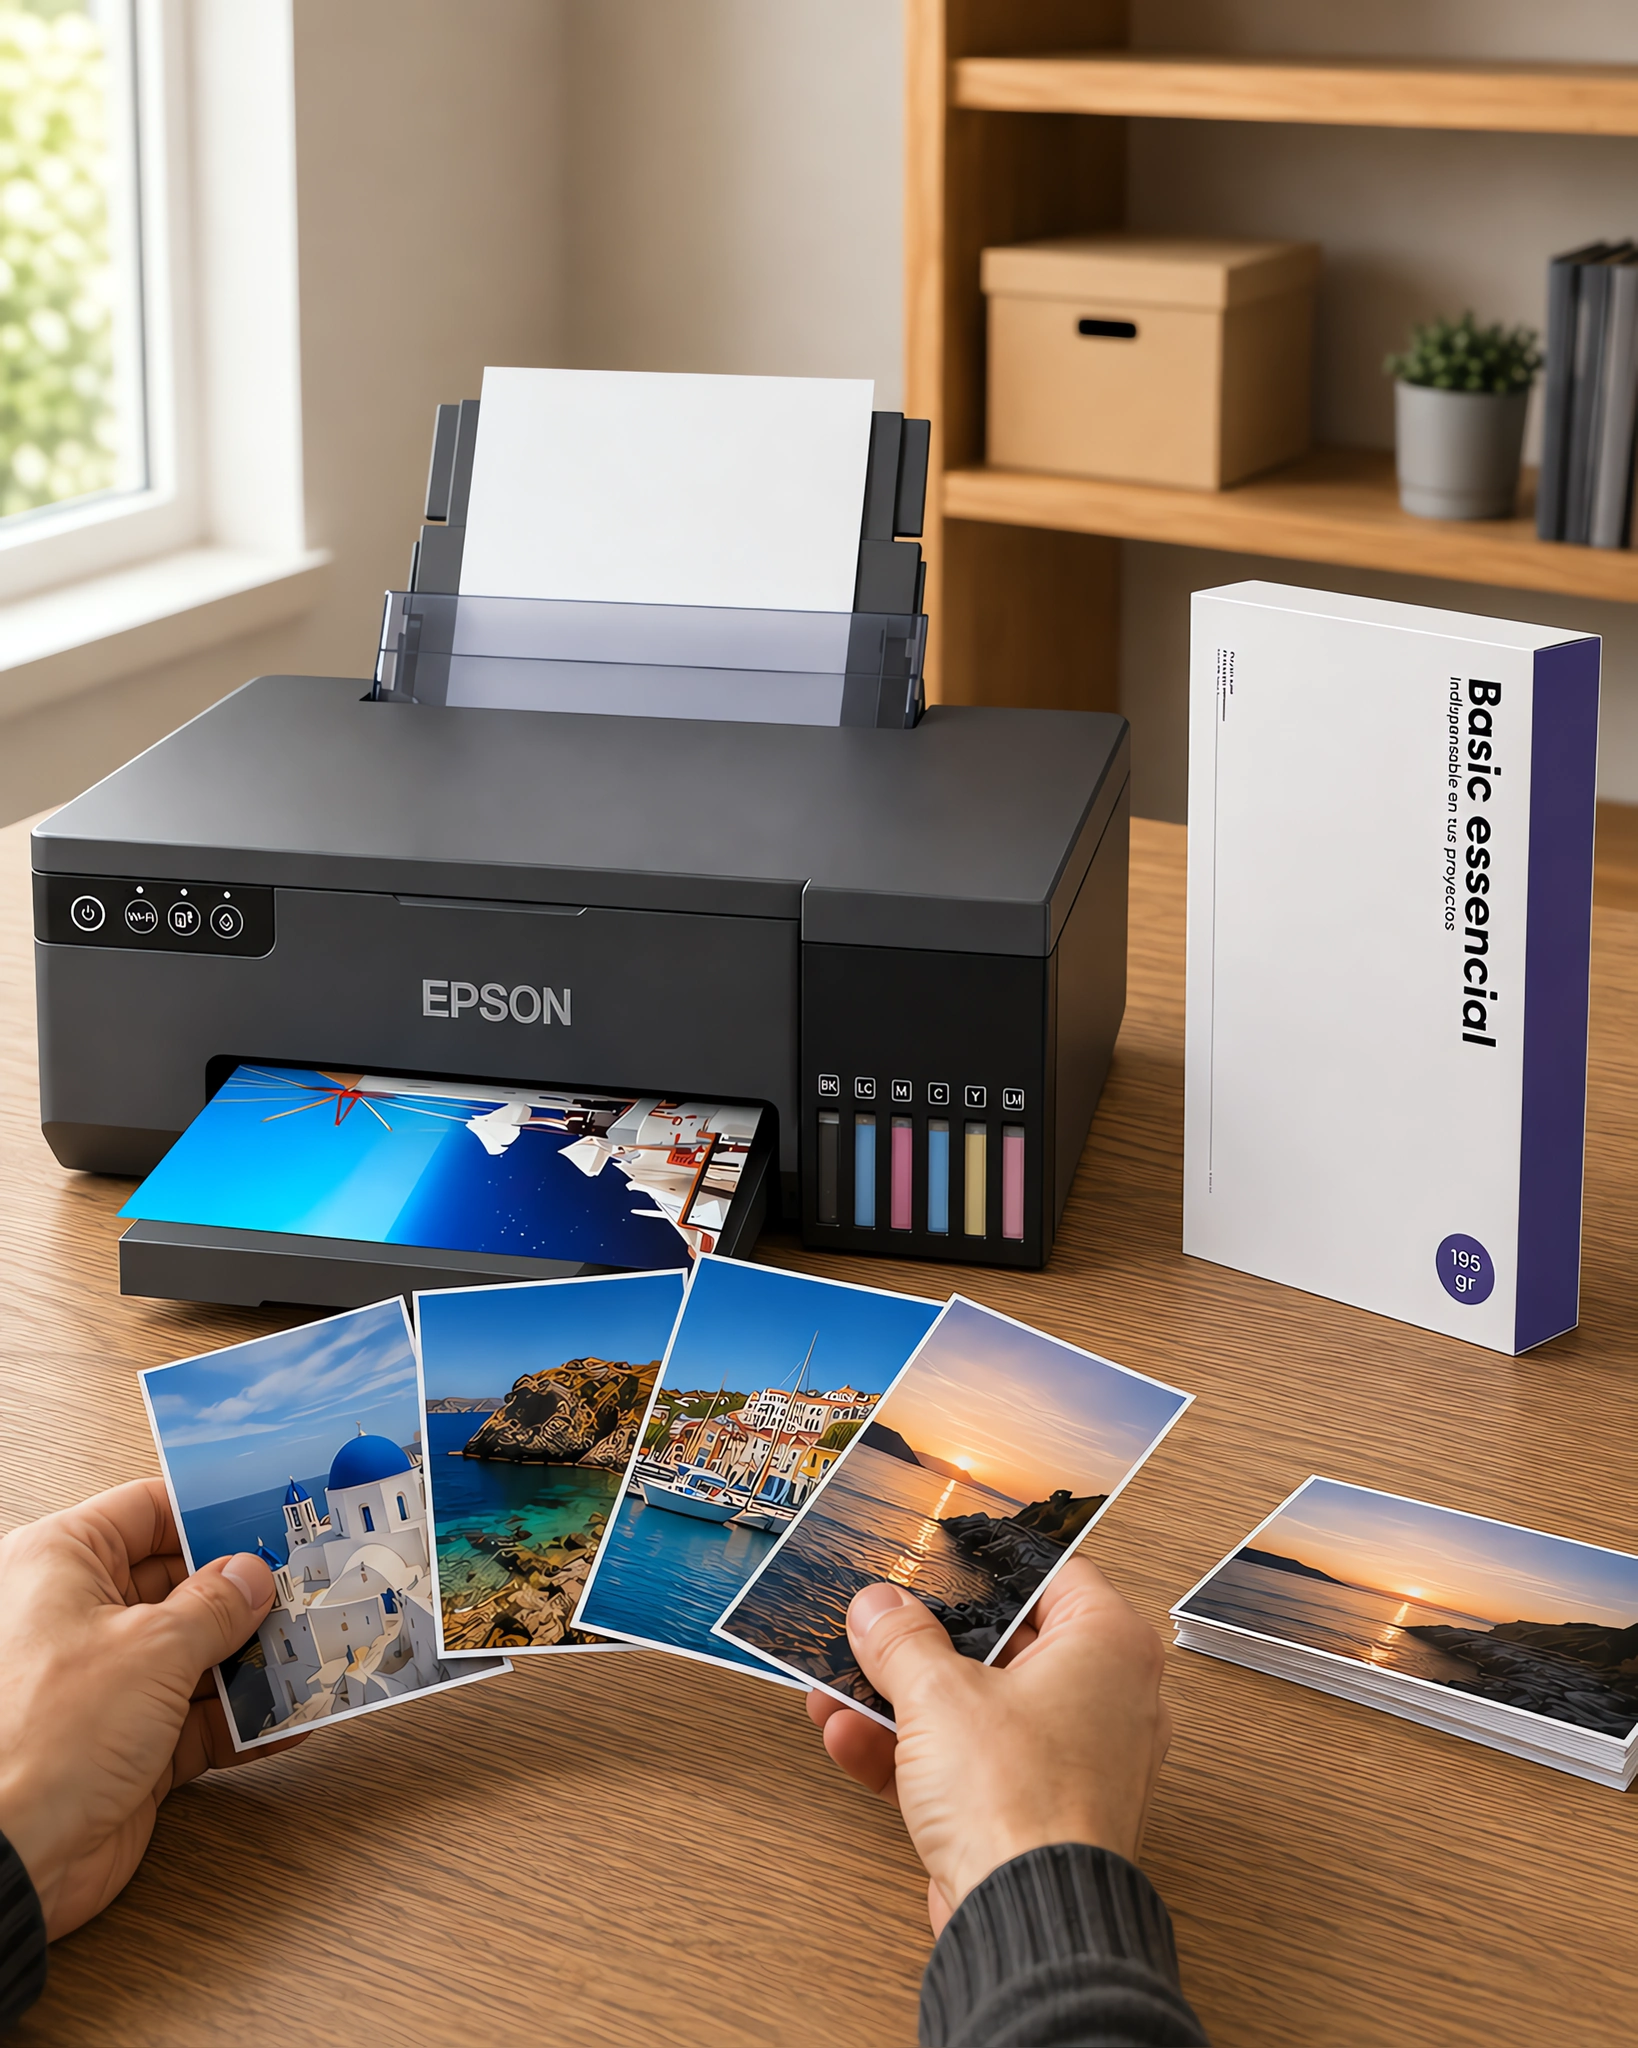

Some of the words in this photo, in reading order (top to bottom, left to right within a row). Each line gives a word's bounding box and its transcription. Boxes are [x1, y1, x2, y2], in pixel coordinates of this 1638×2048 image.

[1466, 678, 1502, 803] Basic
[1447, 792, 1458, 813] en
[1442, 847, 1457, 931] proyectos
[1462, 815, 1498, 1048] essencial
[422, 978, 572, 1026] EPSON
[821, 1079, 837, 1092] BK
[857, 1082, 873, 1094] LC
[895, 1085, 907, 1097] M
[933, 1088, 943, 1100] C
[970, 1090, 981, 1102] Y
[1450, 1248, 1481, 1272] 195
[1455, 1274, 1476, 1293] gr
